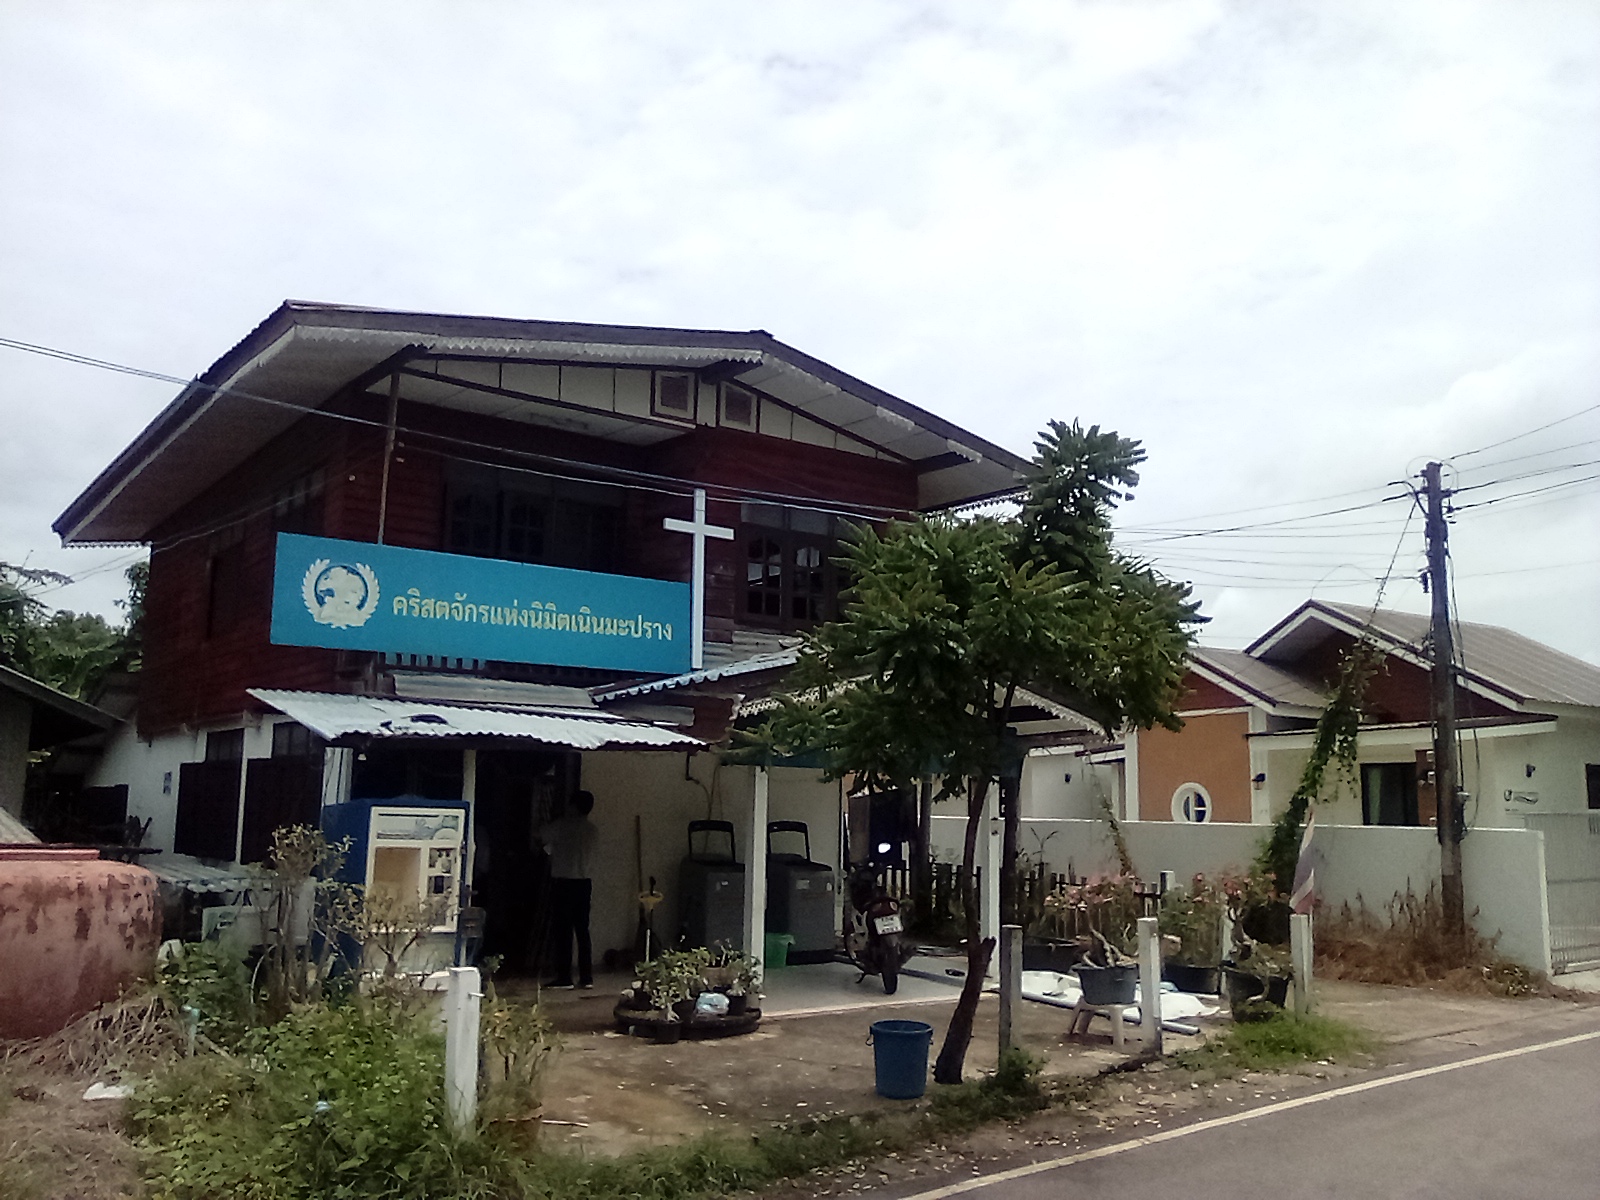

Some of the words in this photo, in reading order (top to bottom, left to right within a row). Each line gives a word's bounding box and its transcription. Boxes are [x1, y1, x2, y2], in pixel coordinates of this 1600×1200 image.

[392, 587, 674, 641] คริสตจักรแห่งนิมิตเนินมะปราง
